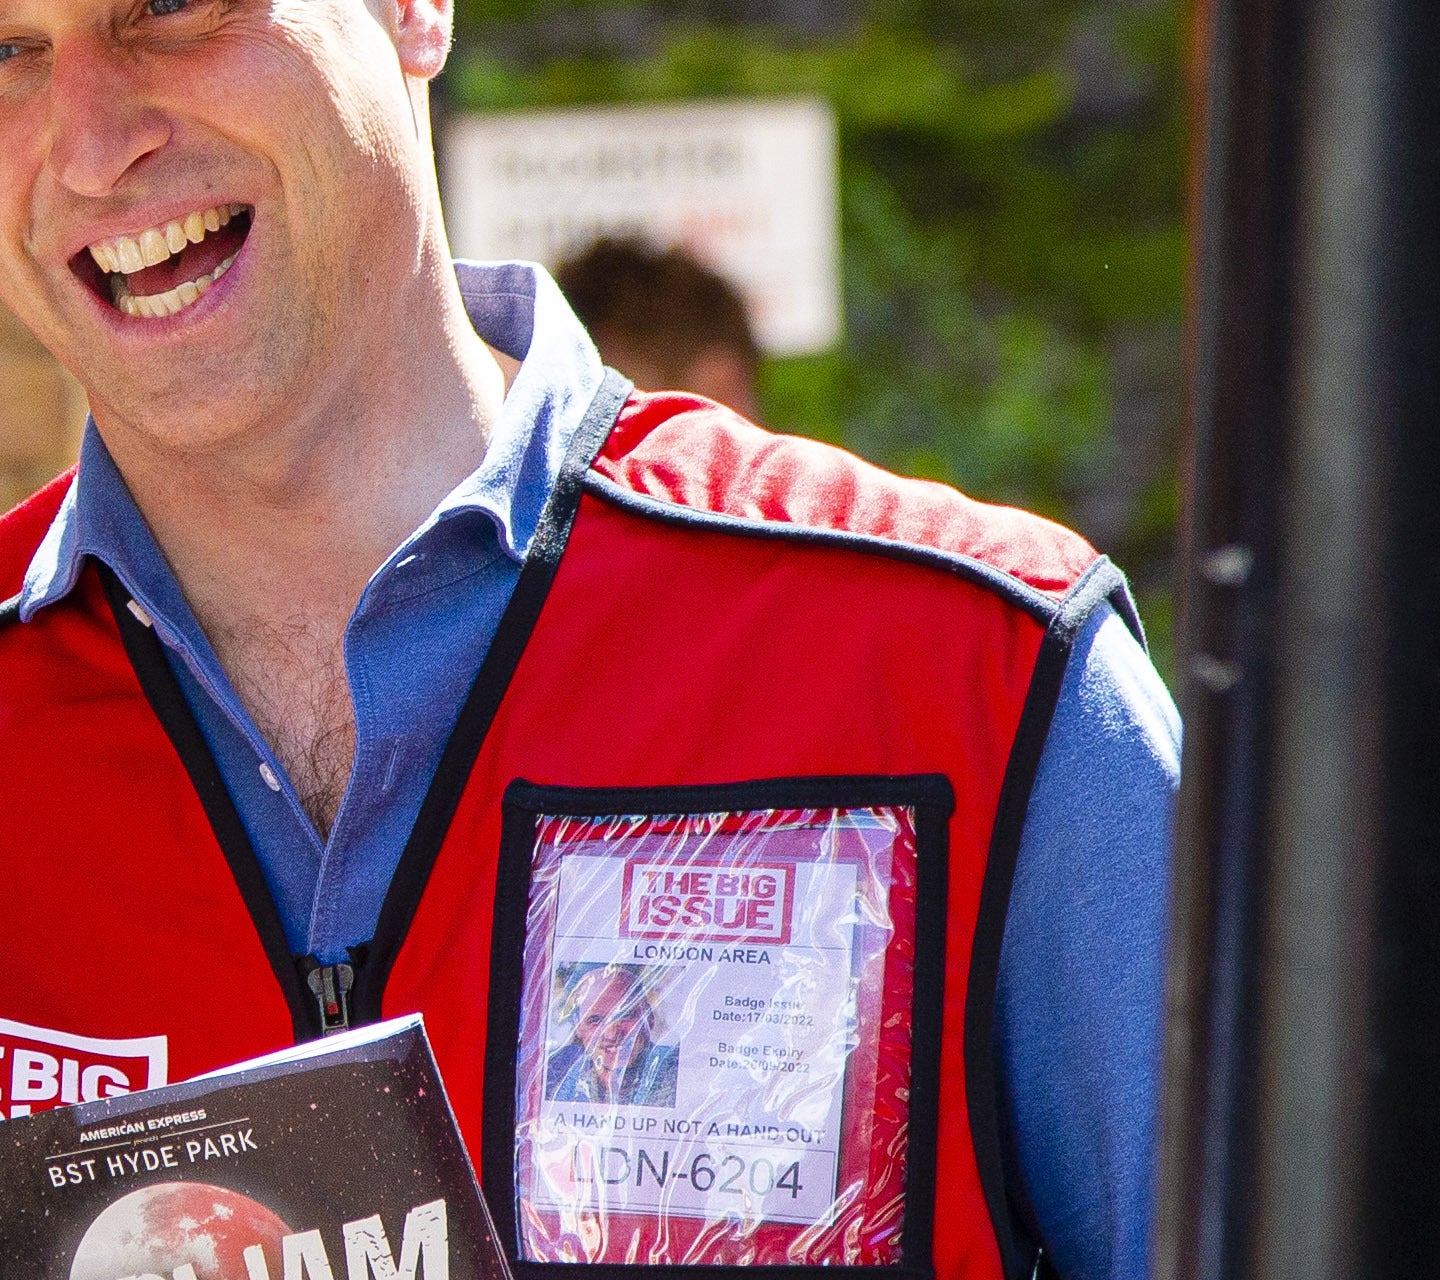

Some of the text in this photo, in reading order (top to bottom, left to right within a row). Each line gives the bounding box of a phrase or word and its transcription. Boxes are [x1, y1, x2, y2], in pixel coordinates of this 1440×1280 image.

[642, 870, 778, 899] THE BIG
[637, 894, 776, 931] ISSUE
[633, 944, 771, 965] LONDON AREA
[724, 995, 766, 1010] Badge
[10, 1048, 131, 1105] BIG
[79, 1122, 145, 1143] AMERICAN
[148, 1108, 207, 1131] EXPRESS
[554, 1112, 826, 1145] A HAND UP NOT A HAND OUT
[48, 1128, 258, 1188] BST HYDE PARK
